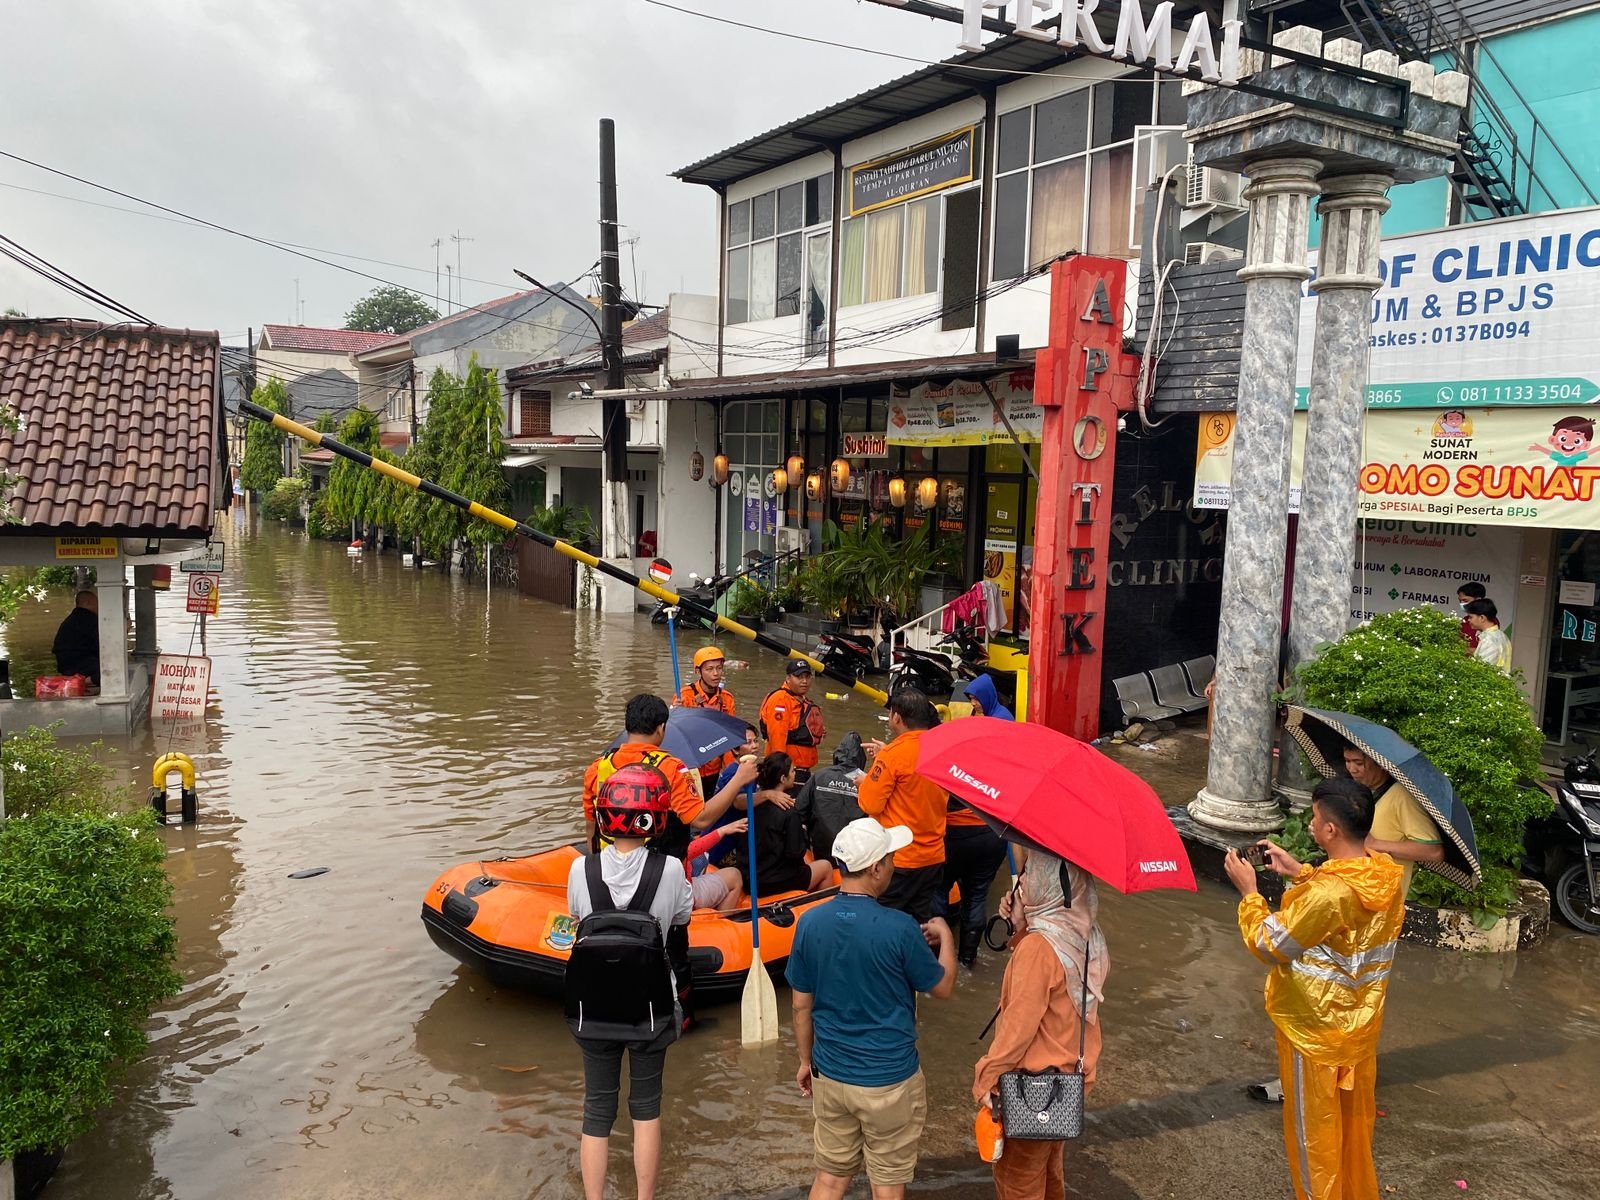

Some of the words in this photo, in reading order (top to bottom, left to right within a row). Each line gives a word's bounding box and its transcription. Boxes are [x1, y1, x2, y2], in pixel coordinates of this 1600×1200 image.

[854, 171, 879, 187] RUMAH
[909, 150, 936, 168] DARUL
[935, 138, 969, 157] MUTQIN
[862, 176, 892, 193] TEMPAT
[895, 168, 915, 182] PARA
[919, 155, 958, 174] PEJUANG
[885, 177, 930, 198] AL-QUR'AN
[1432, 228, 1600, 284] CLINIC
[1421, 294, 1442, 319] &
[1456, 283, 1555, 316] BPJS
[1431, 320, 1530, 344] 0137B094
[1459, 387, 1487, 402] 081
[1494, 385, 1534, 400] 1133
[1538, 384, 1581, 399] 3504
[844, 435, 887, 456] Sushimi
[1430, 438, 1473, 448] SUNAT
[1423, 450, 1478, 460] MODERN
[1058, 277, 1114, 656] APOTEK
[1359, 462, 1451, 498] OMO
[1456, 464, 1600, 501] SUNAT
[1380, 501, 1425, 513] SPESIAL
[1427, 503, 1453, 516] Bagi
[1456, 505, 1503, 516] Peserta
[1507, 507, 1538, 518] BPJS
[939, 519, 963, 529] SUSHIMI
[1108, 558, 1222, 586] CLINIC
[1404, 566, 1491, 583] LABORATORIUM
[196, 581, 210, 594] 15
[1402, 591, 1449, 605] FARMASI
[160, 663, 197, 678] MOHON
[181, 697, 201, 705] BESAR
[948, 764, 1001, 800] NISSAN
[1139, 860, 1178, 873] NISSAN
